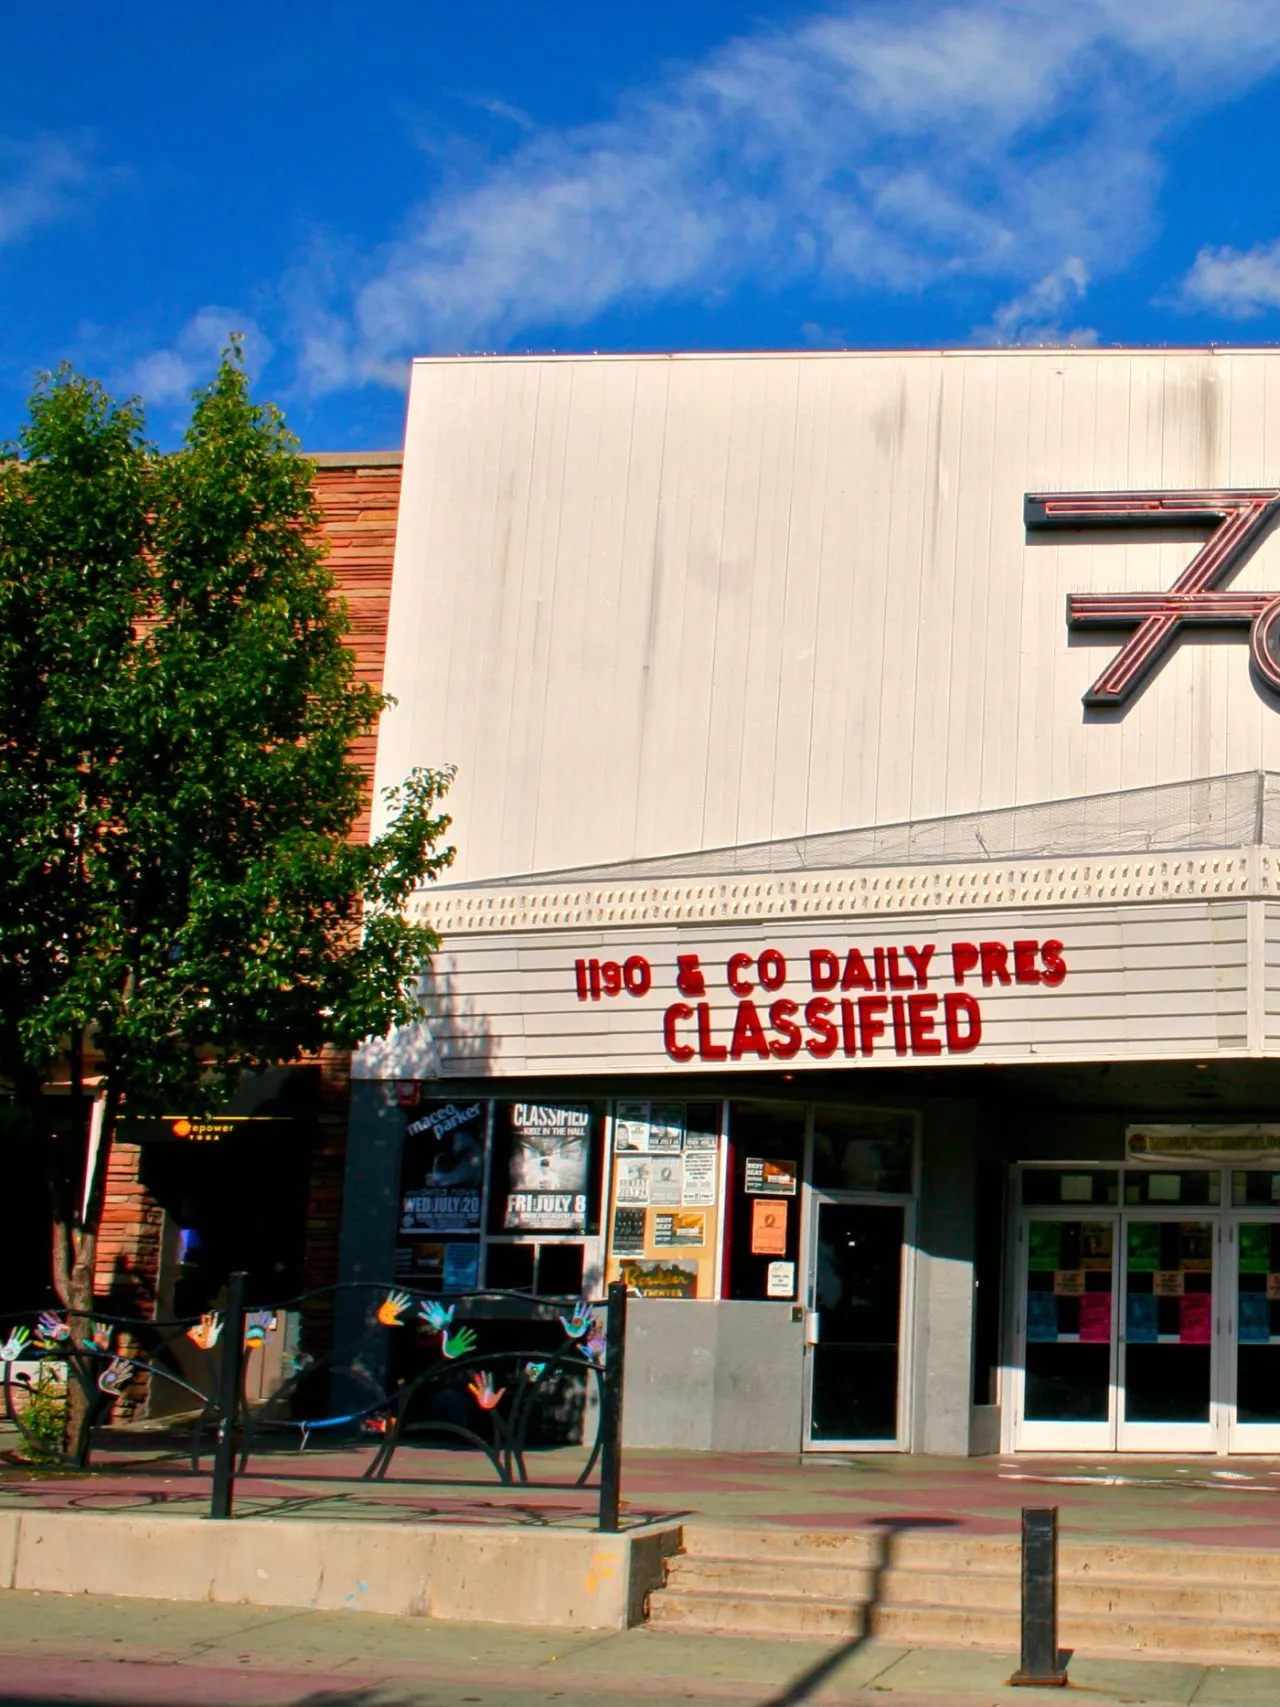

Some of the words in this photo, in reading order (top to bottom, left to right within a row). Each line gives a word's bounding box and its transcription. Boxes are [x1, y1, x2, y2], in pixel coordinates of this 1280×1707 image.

[677, 954, 706, 997] &
[727, 948, 787, 997] CO
[809, 944, 936, 991] DAILY
[952, 939, 1068, 987] PRES
[664, 992, 982, 1061] CLASSIFIED
[407, 1103, 457, 1136] maceo
[432, 1103, 481, 1141] parker
[513, 1103, 590, 1126] CLASSIFIED
[542, 1126, 551, 1136] IN
[552, 1126, 567, 1136] THE
[567, 1126, 586, 1136] HALL
[403, 1196, 431, 1213] WED
[433, 1196, 461, 1213] JULY
[463, 1196, 479, 1213] 20
[507, 1194, 533, 1213] FRI
[534, 1194, 572, 1213] JULY
[574, 1194, 586, 1213] 8
